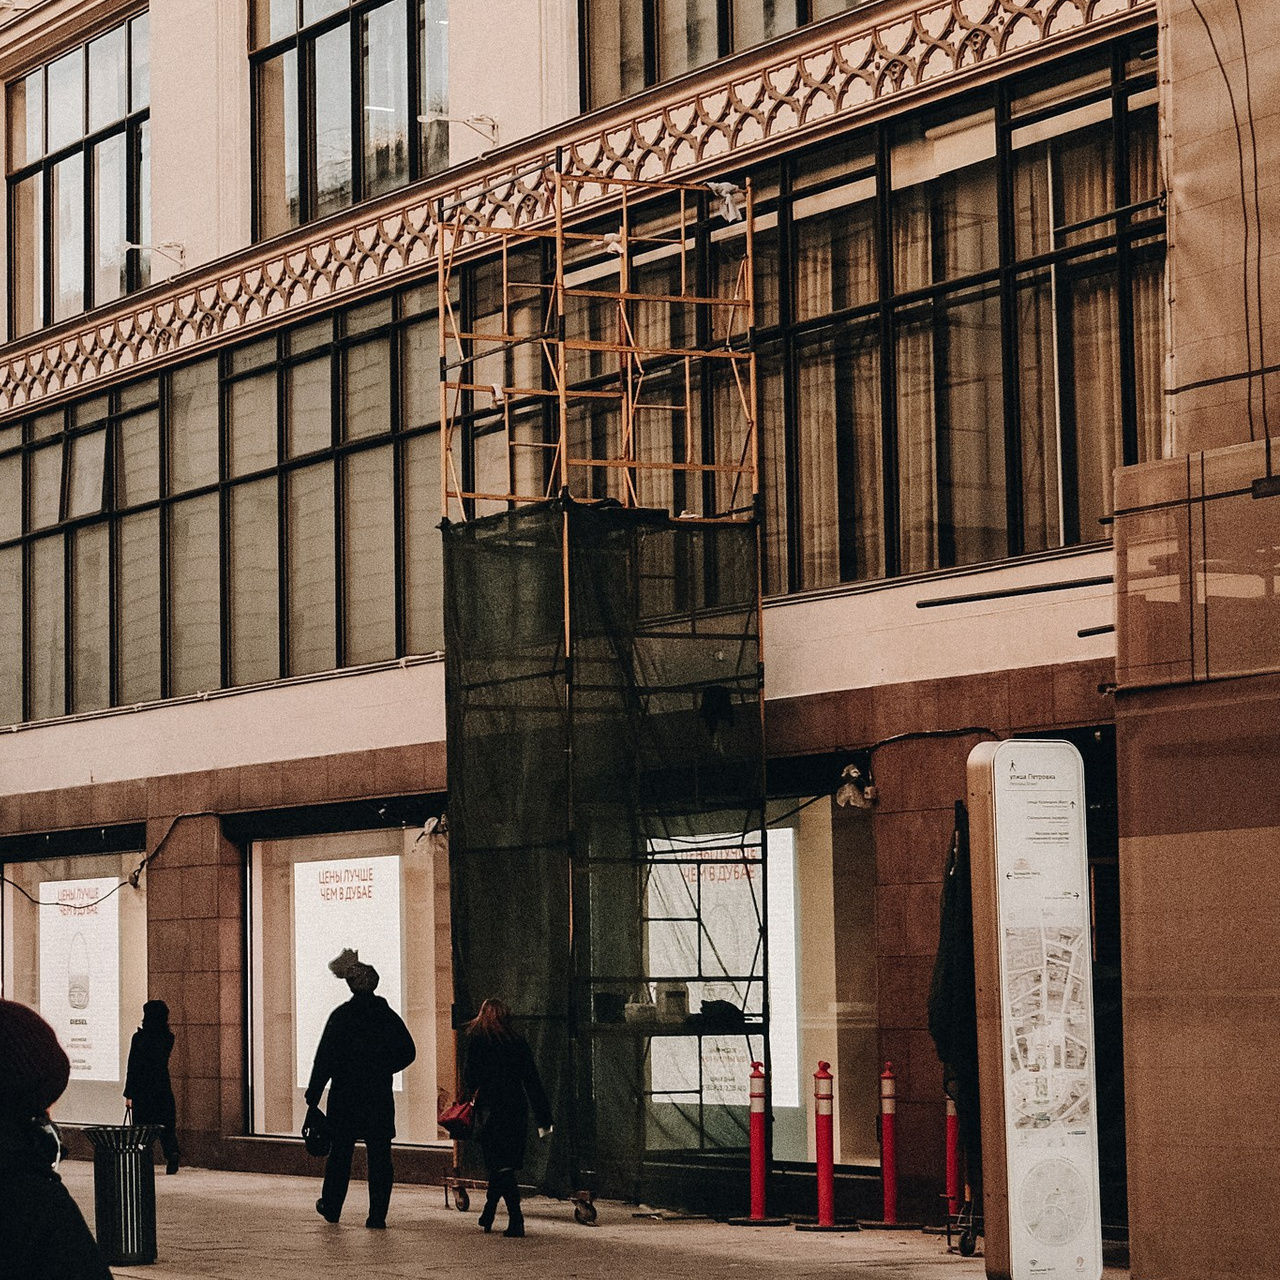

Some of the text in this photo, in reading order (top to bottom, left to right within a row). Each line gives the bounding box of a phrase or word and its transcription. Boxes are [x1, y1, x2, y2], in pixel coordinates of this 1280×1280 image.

[319, 868, 373, 885] ЦЕНЫ ЛУЧШЕ
[320, 885, 372, 901] ЧЕМ В ДУБАЕ
